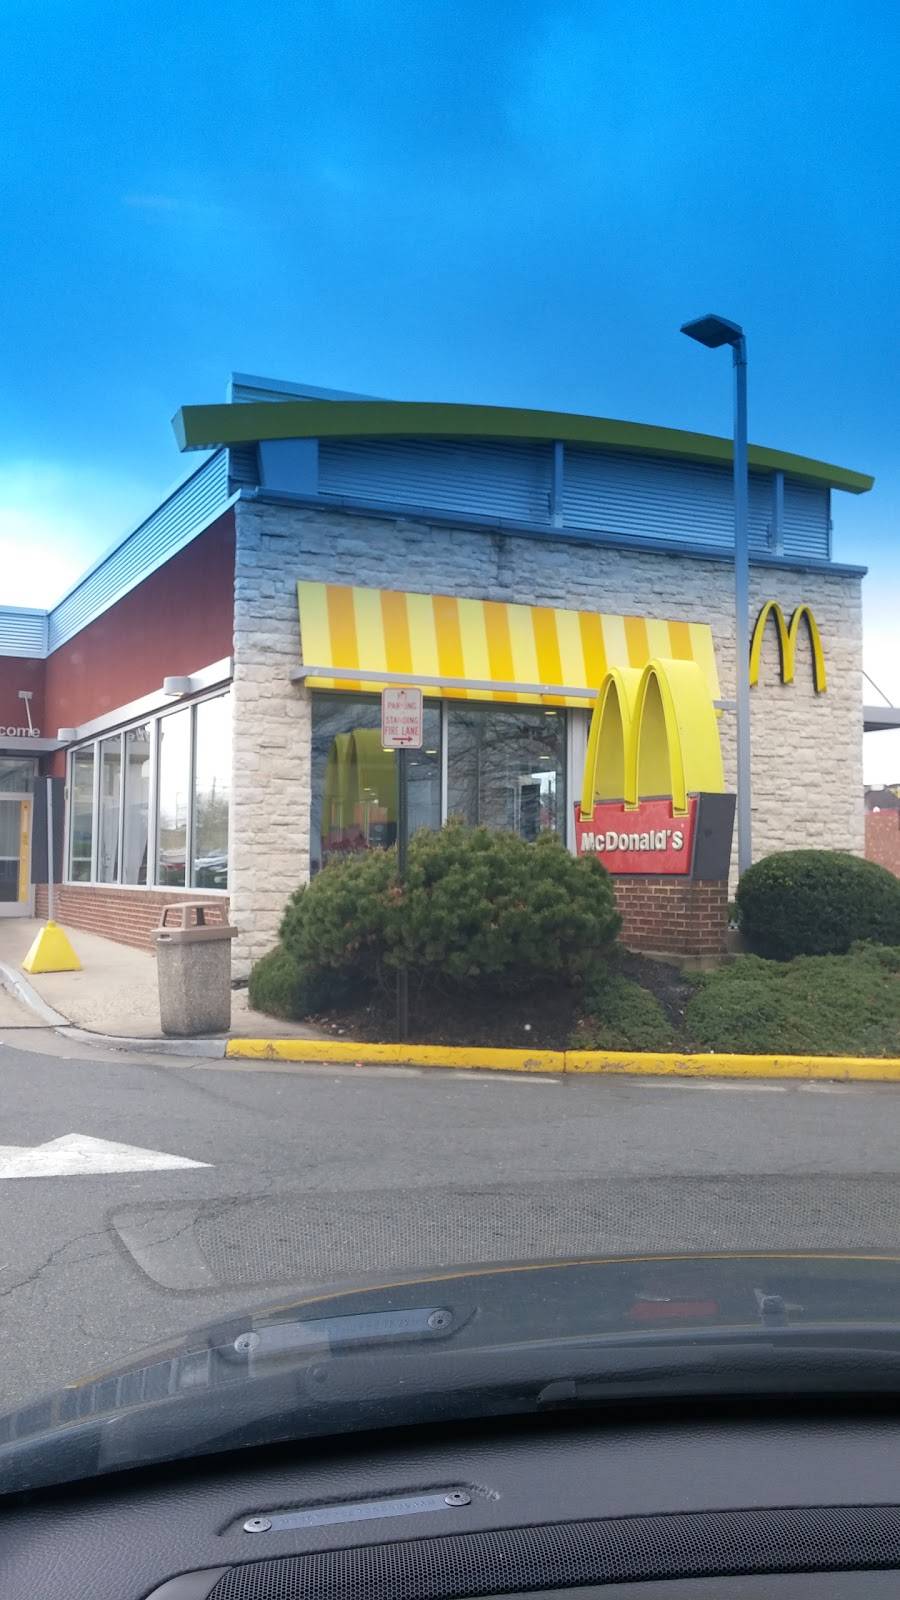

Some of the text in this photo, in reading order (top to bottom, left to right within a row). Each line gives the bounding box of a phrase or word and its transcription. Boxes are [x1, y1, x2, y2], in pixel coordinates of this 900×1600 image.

[384, 726, 419, 736] FIRE LANE
[581, 829, 684, 852] McDonald's
